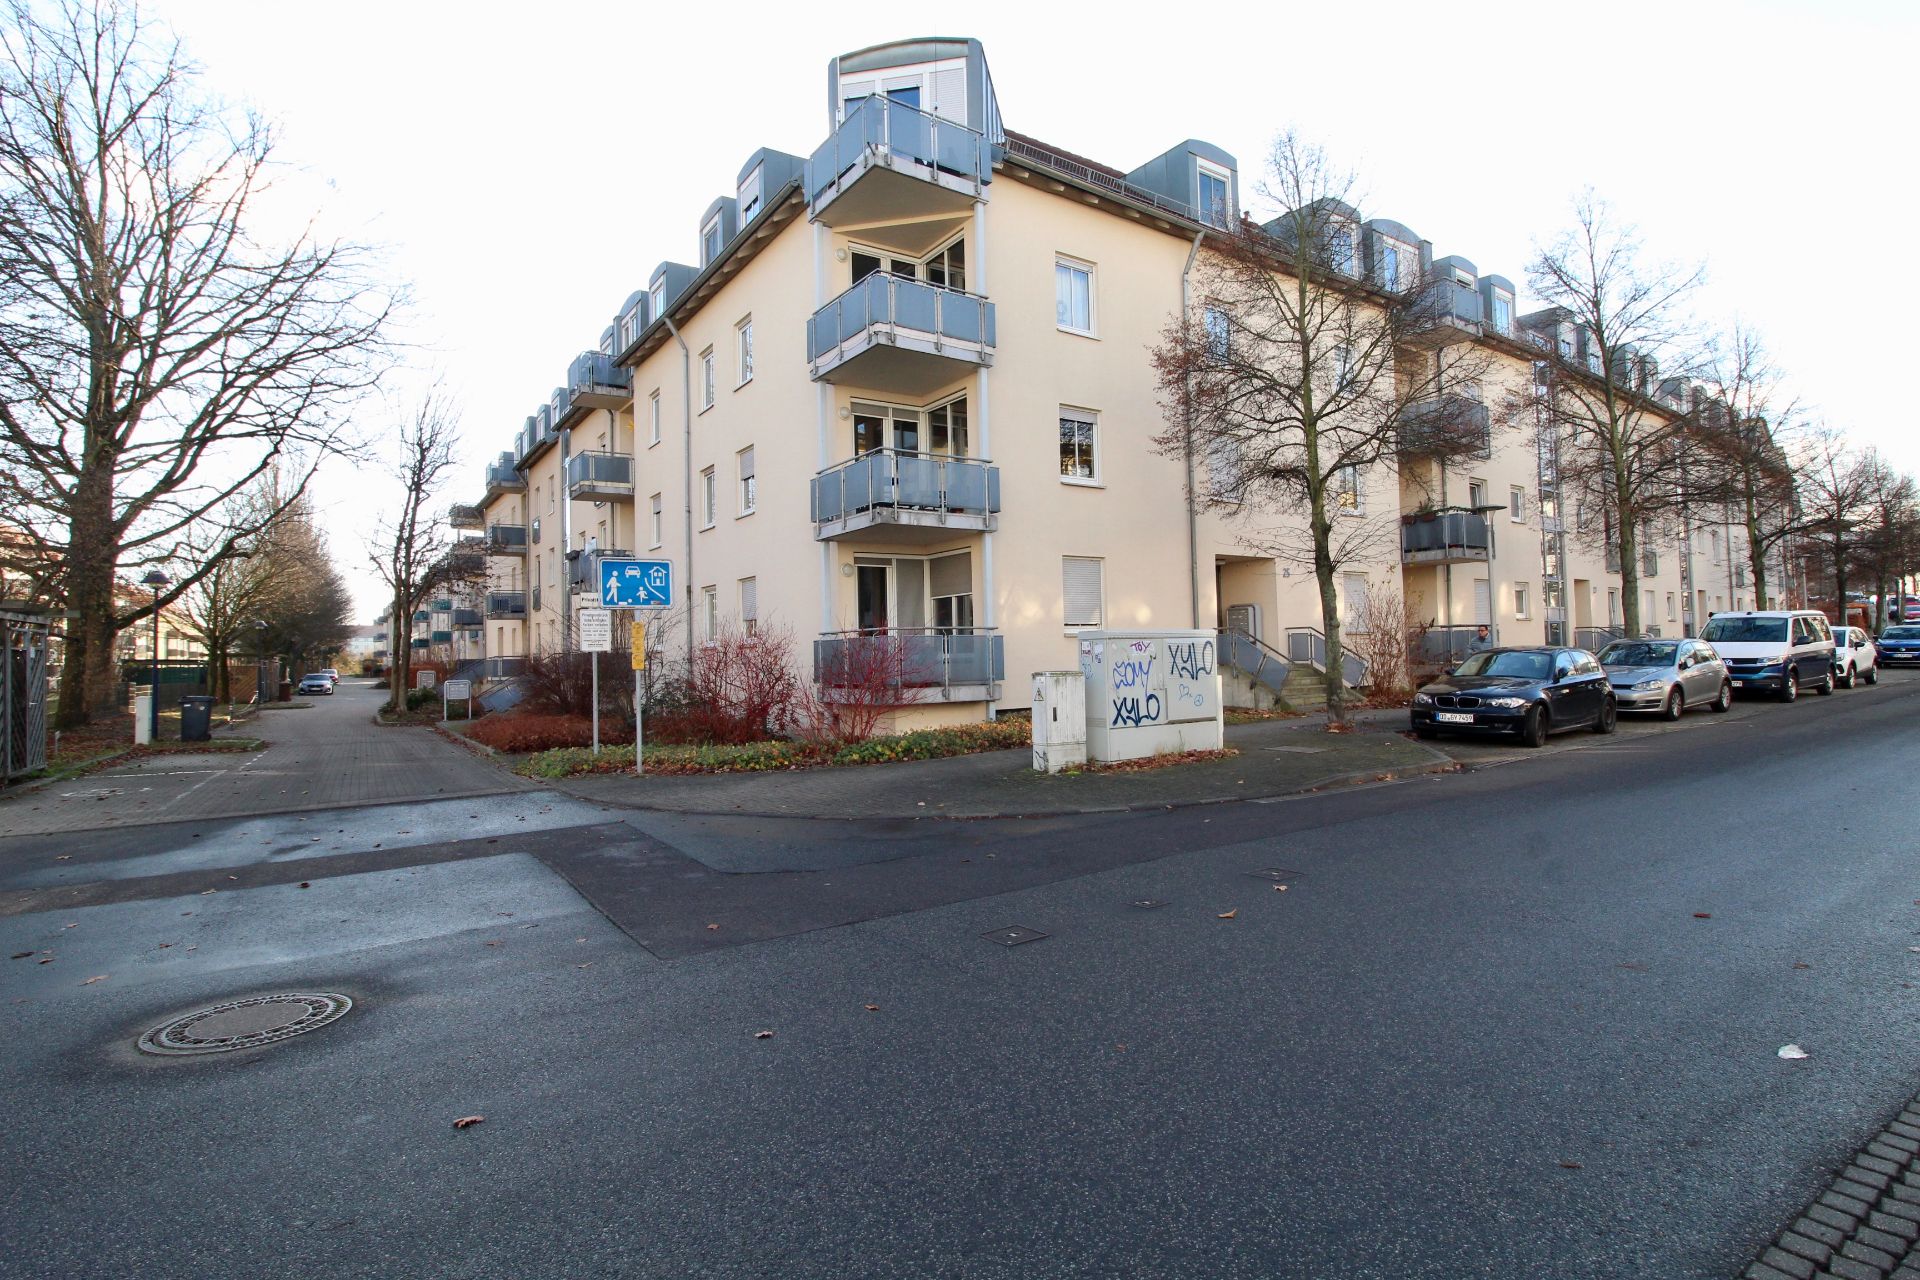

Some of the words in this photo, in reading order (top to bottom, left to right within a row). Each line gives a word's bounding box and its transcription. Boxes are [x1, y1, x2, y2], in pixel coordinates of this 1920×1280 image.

[1129, 641, 1152, 652] TOY
[1168, 640, 1214, 681] XYLO
[1112, 693, 1160, 729] XYLO
